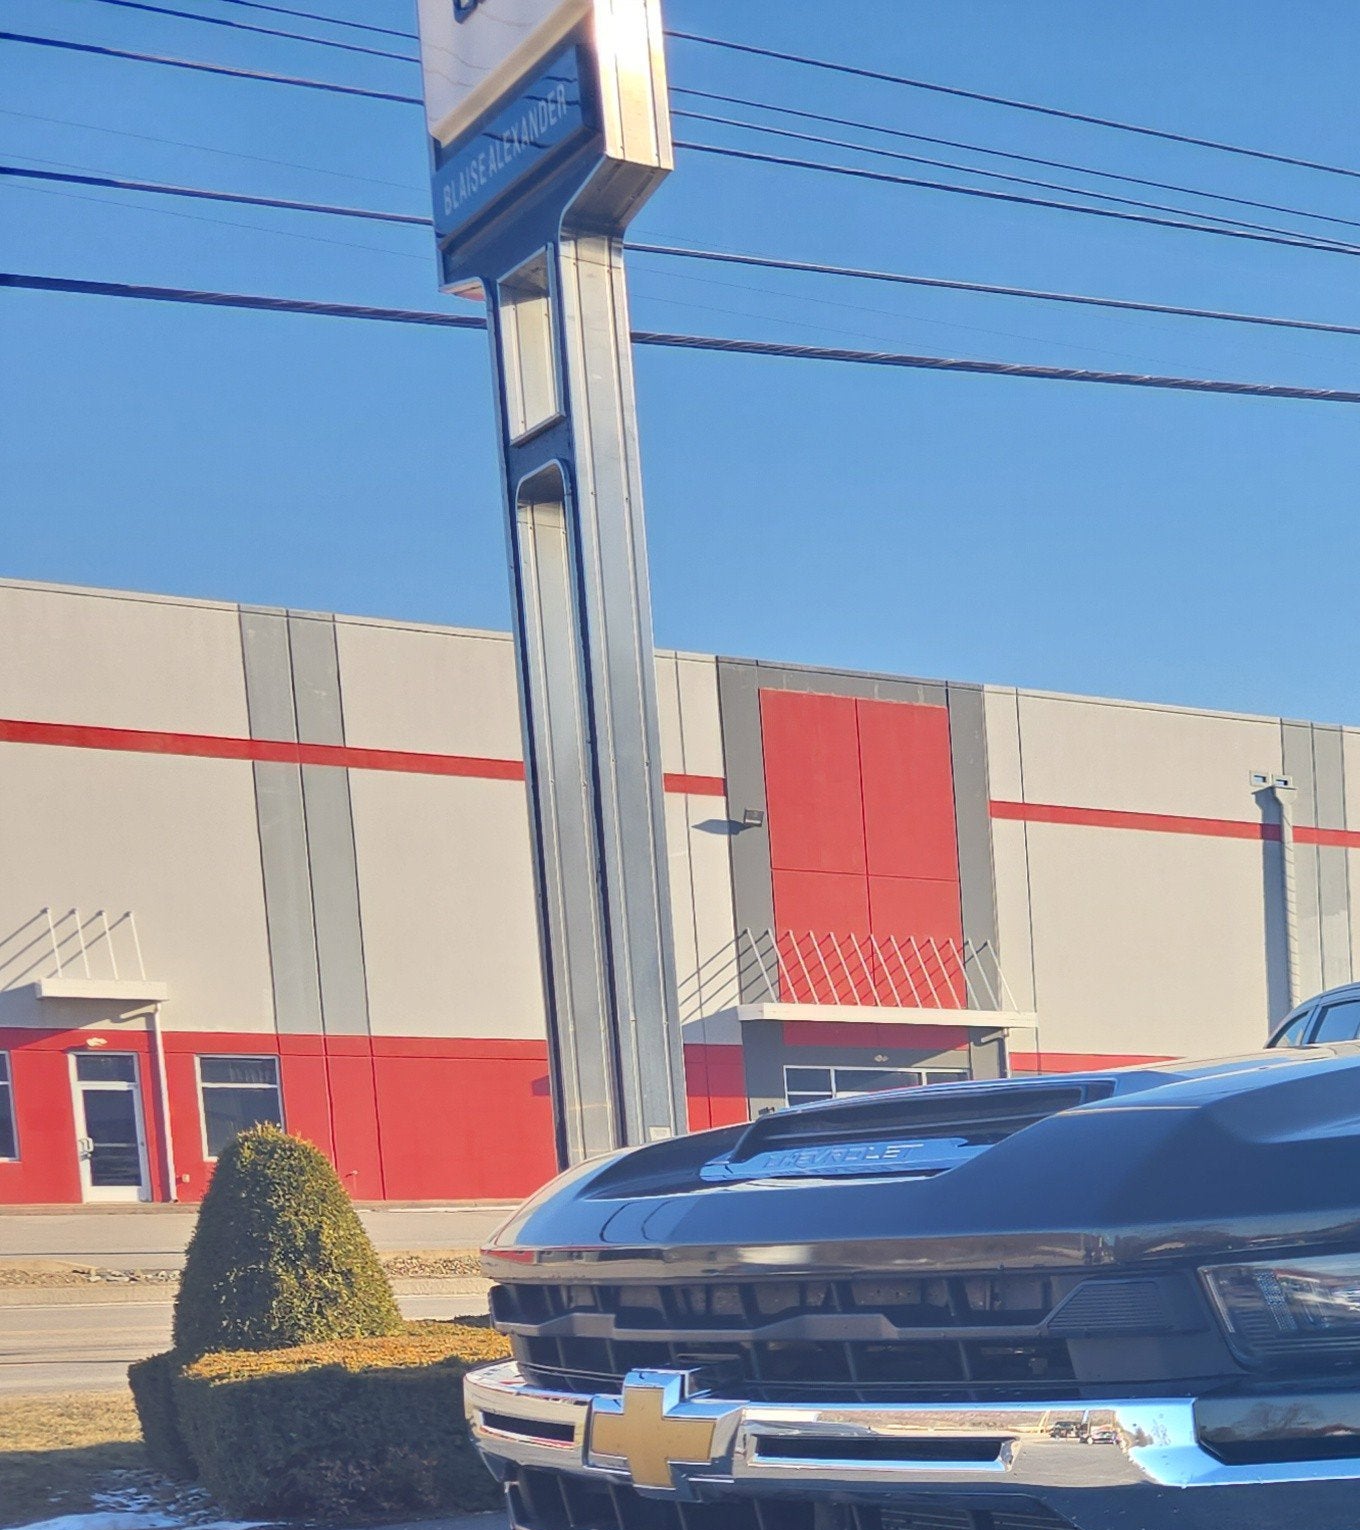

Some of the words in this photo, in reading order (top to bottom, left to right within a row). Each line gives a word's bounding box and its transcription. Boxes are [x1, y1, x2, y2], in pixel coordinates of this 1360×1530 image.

[442, 152, 487, 216] BLAISE
[488, 83, 567, 178] ALEXANDER
[763, 1143, 925, 1169] CHEVROLET
